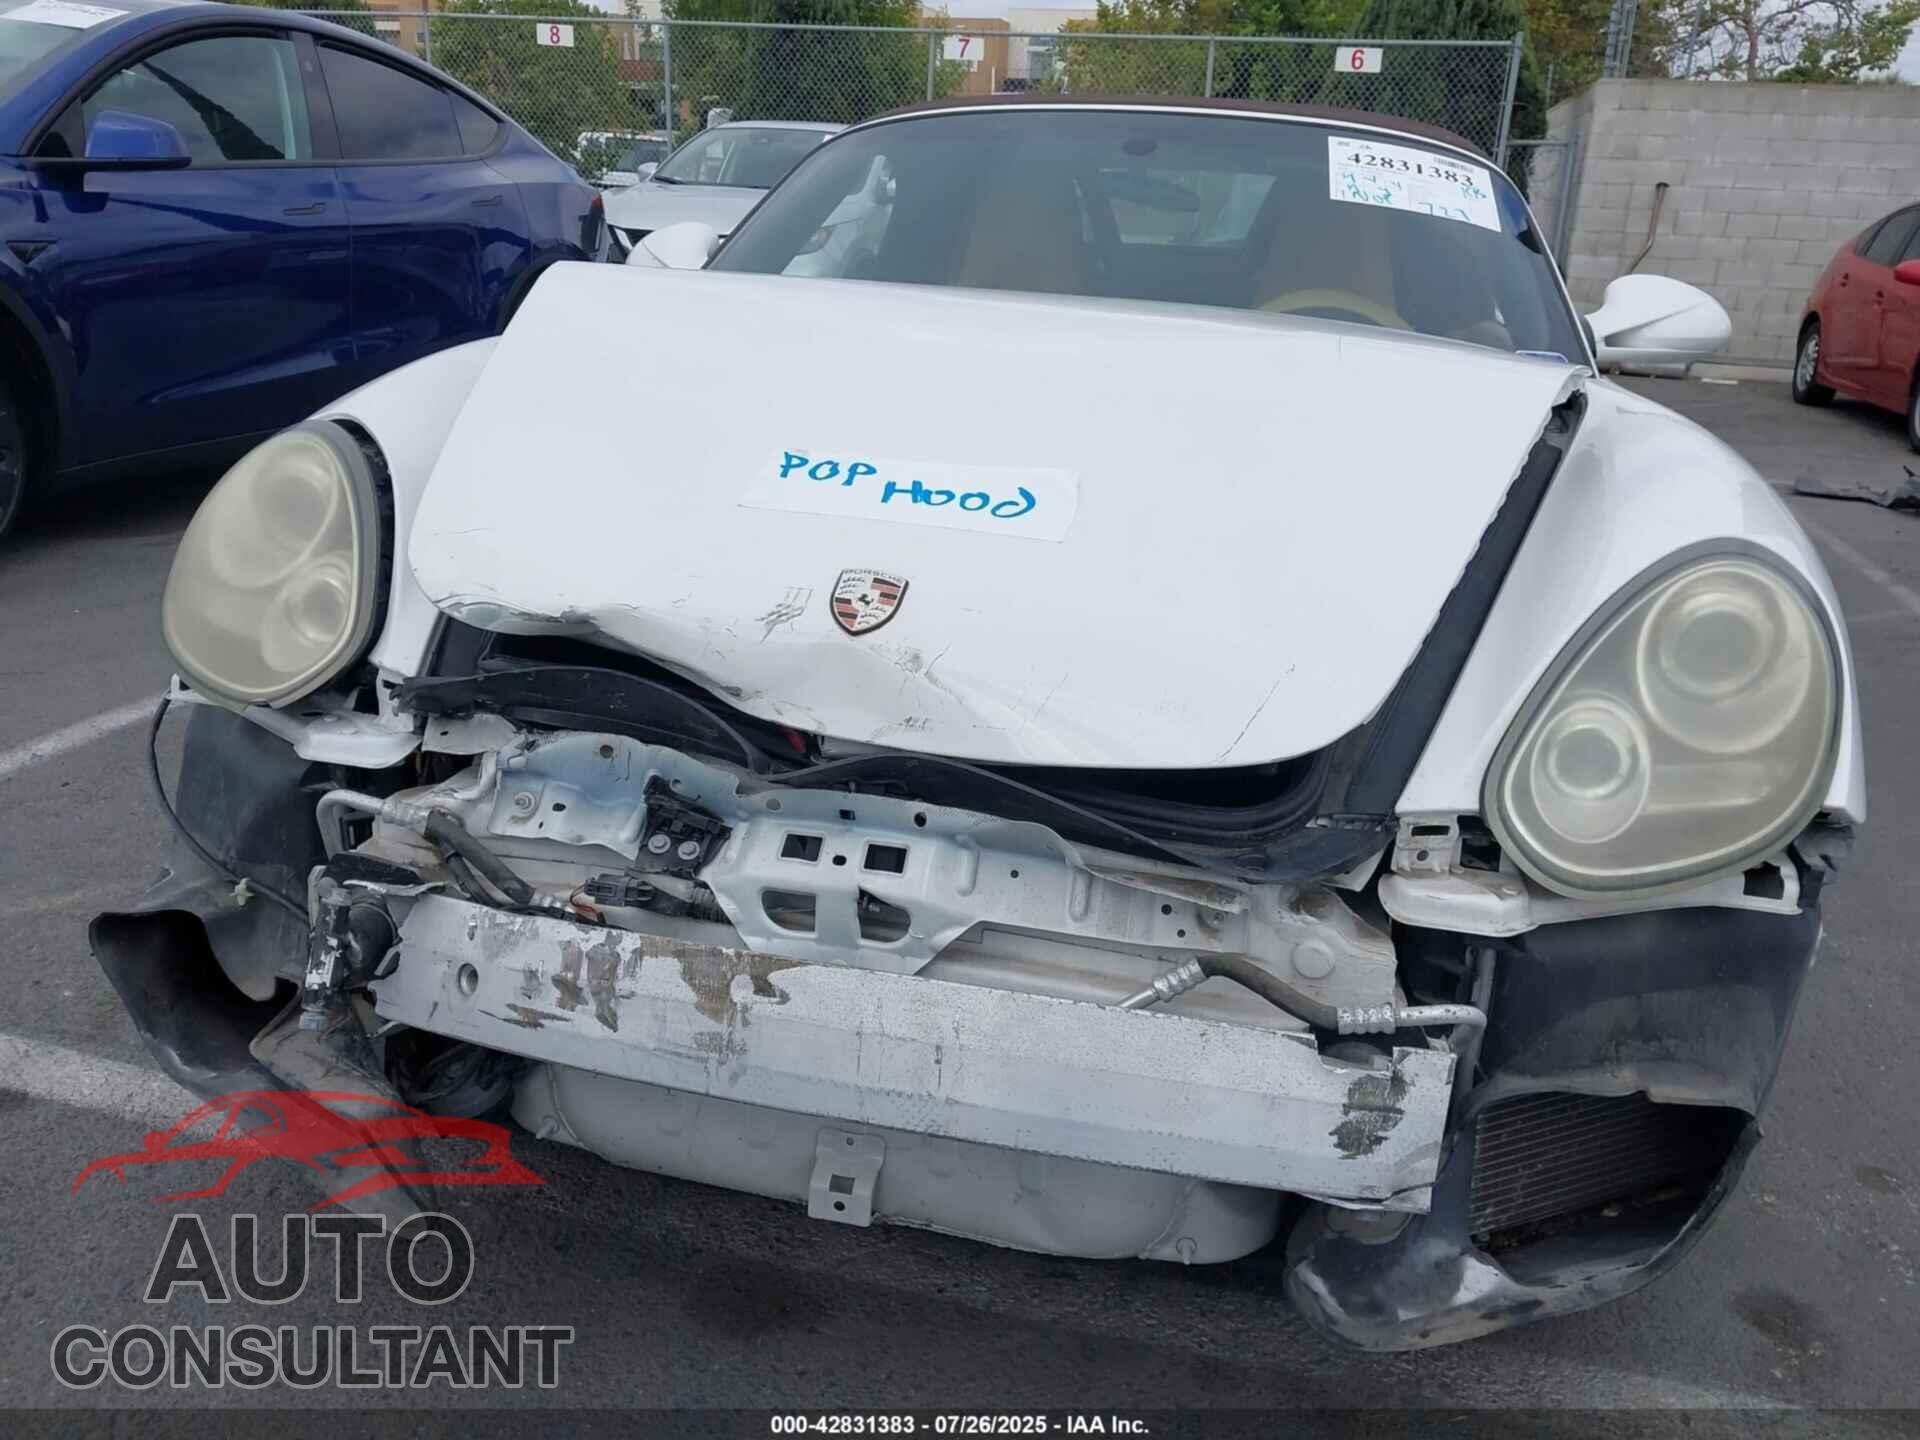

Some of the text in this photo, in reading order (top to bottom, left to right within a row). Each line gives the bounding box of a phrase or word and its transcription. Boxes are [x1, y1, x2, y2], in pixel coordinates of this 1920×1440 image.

[550, 25, 560, 44] 8
[959, 38, 970, 58] 7
[1351, 49, 1365, 70] 6
[1347, 152, 1473, 186] 42831383
[780, 451, 877, 486] POP
